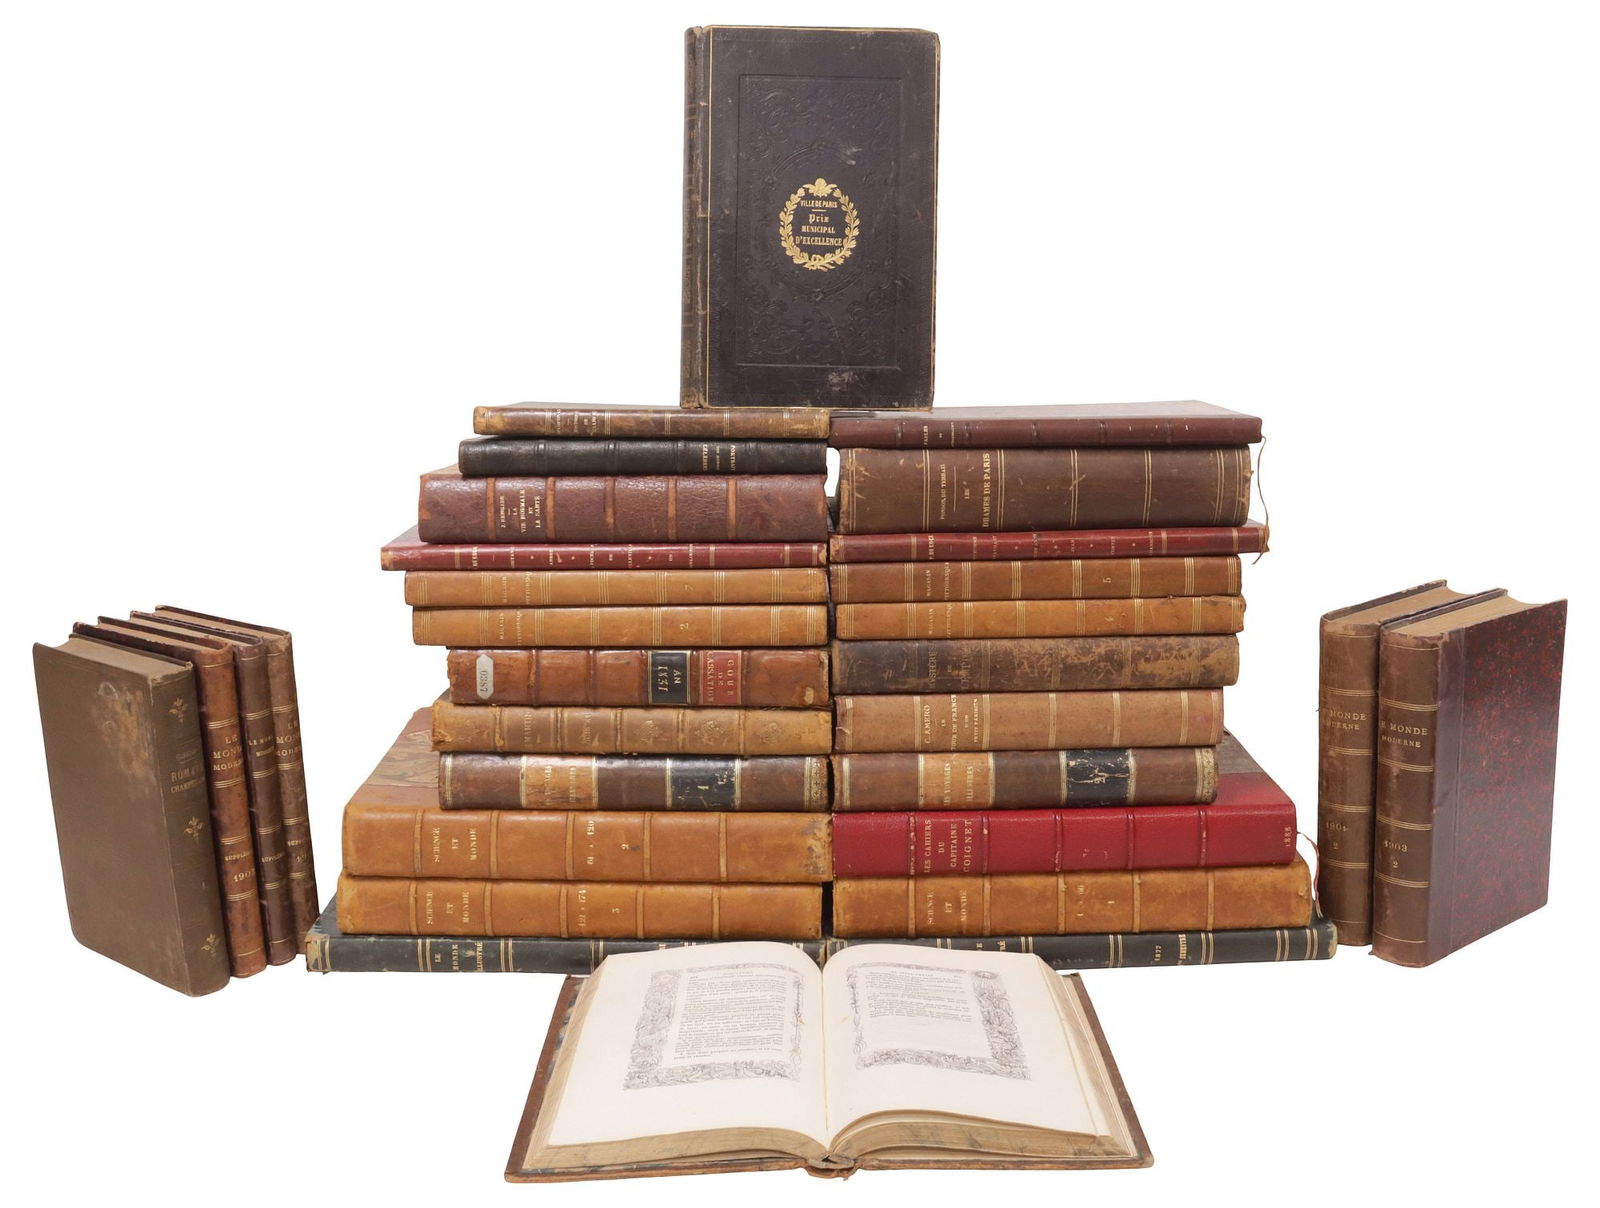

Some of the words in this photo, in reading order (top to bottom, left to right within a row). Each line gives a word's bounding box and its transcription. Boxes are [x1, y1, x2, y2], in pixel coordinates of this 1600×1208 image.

[801, 200, 814, 208] VILLE
[815, 200, 822, 208] DE
[823, 200, 838, 208] PARIS
[809, 213, 829, 223] Prix
[802, 226, 835, 234] MUNICIPAL
[796, 236, 843, 246] D'EXCELLENCE
[983, 453, 991, 480] PARIS
[983, 482, 991, 494] DE
[982, 496, 991, 528] DRAMES
[1102, 576, 1112, 584] 5
[680, 622, 689, 630] 2
[673, 669, 682, 685] AN
[1330, 710, 1367, 721] MONDE
[1390, 722, 1428, 736] MONDE
[225, 734, 239, 744] LE
[1381, 735, 1421, 748] MODERNE
[451, 838, 459, 849] ET
[924, 819, 932, 857] CAHIERS
[938, 841, 945, 853] DU
[950, 823, 958, 868] CAPITAINE
[963, 819, 972, 873] COIGNET
[1393, 859, 1399, 869] 2
[446, 902, 454, 914] ET
[944, 902, 952, 913] ET
[1154, 945, 1162, 961] 1877
